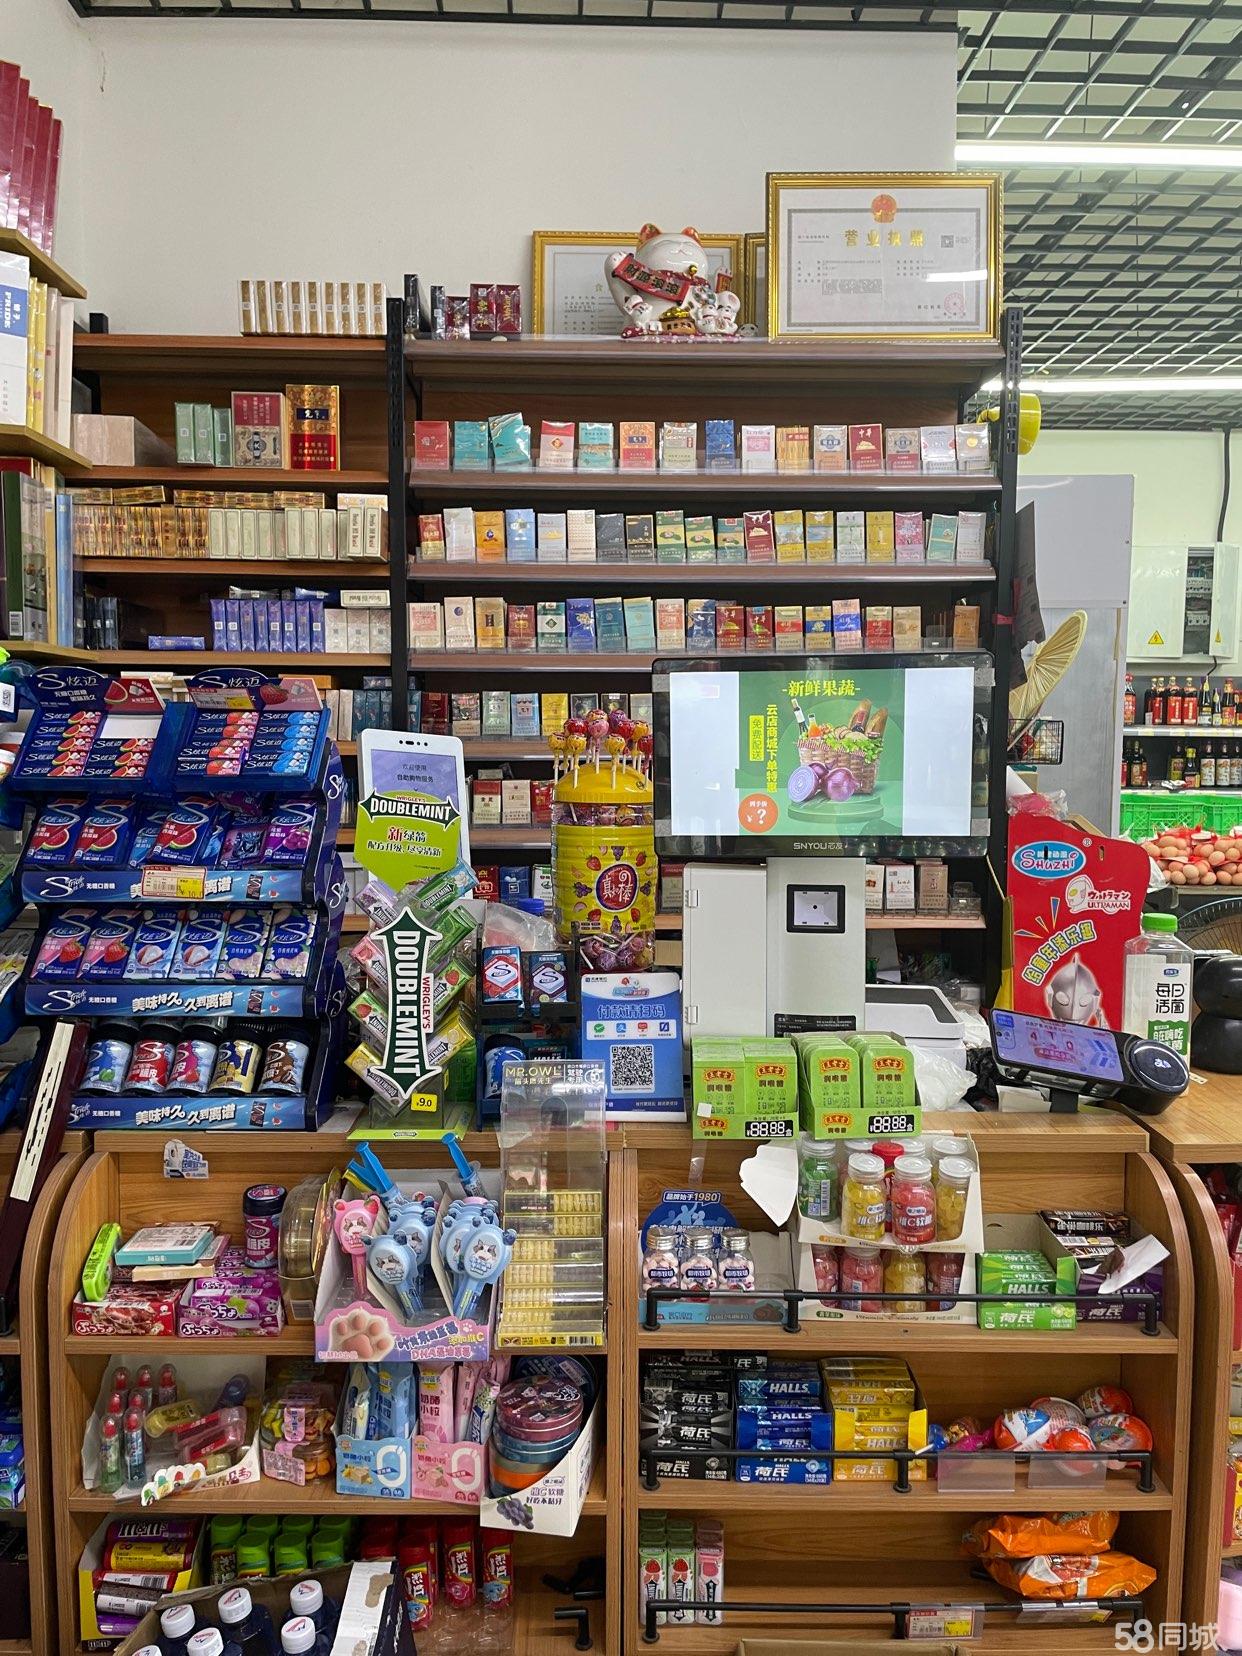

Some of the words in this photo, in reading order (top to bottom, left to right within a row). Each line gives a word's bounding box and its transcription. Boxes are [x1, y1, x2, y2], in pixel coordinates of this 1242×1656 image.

[370, 798, 452, 820] DOUBLEMINT
[1087, 891, 1131, 900] ウルトラマン
[1087, 901, 1131, 909] ULTRAMAN
[1022, 919, 1097, 986] 给童年添乐趣
[1155, 982, 1185, 998] 每日
[392, 930, 421, 1077] DOUBLEMINT
[422, 976, 431, 1029] WRIGLEY'S
[1155, 999, 1185, 1014] 活菌
[597, 1003, 667, 1019] 付款请扫码
[505, 1066, 561, 1077] MR.OWL
[1007, 1283, 1050, 1295] HALLS
[769, 1383, 809, 1394] HALLS
[772, 1412, 812, 1420] HALLS
[866, 1438, 906, 1448] HALLS
